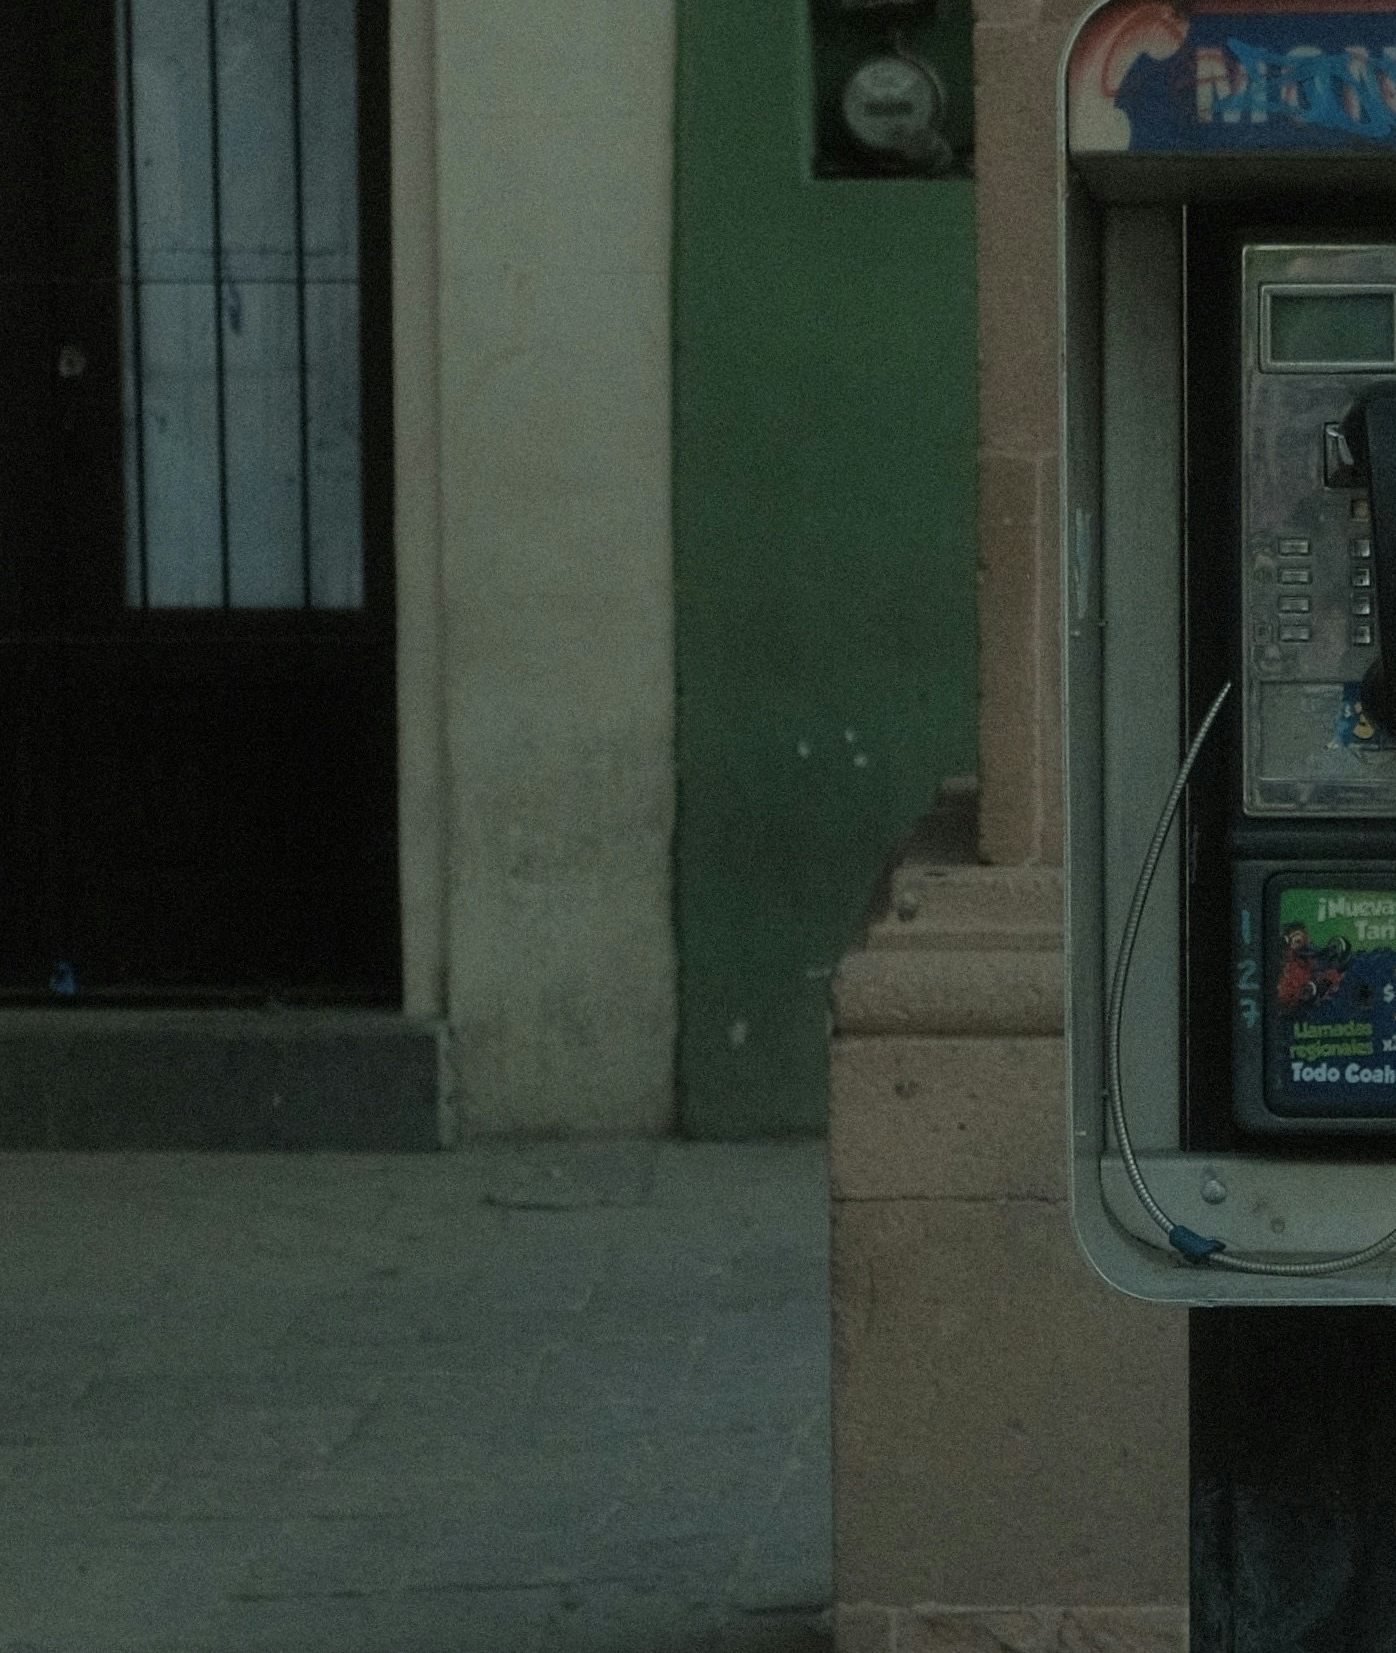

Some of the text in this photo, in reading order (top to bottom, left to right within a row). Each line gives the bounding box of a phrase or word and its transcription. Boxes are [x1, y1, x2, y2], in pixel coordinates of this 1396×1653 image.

[1293, 1021, 1374, 1039] Llamadas
[1289, 1038, 1375, 1061] regionales
[1290, 1061, 1341, 1083] Todo
